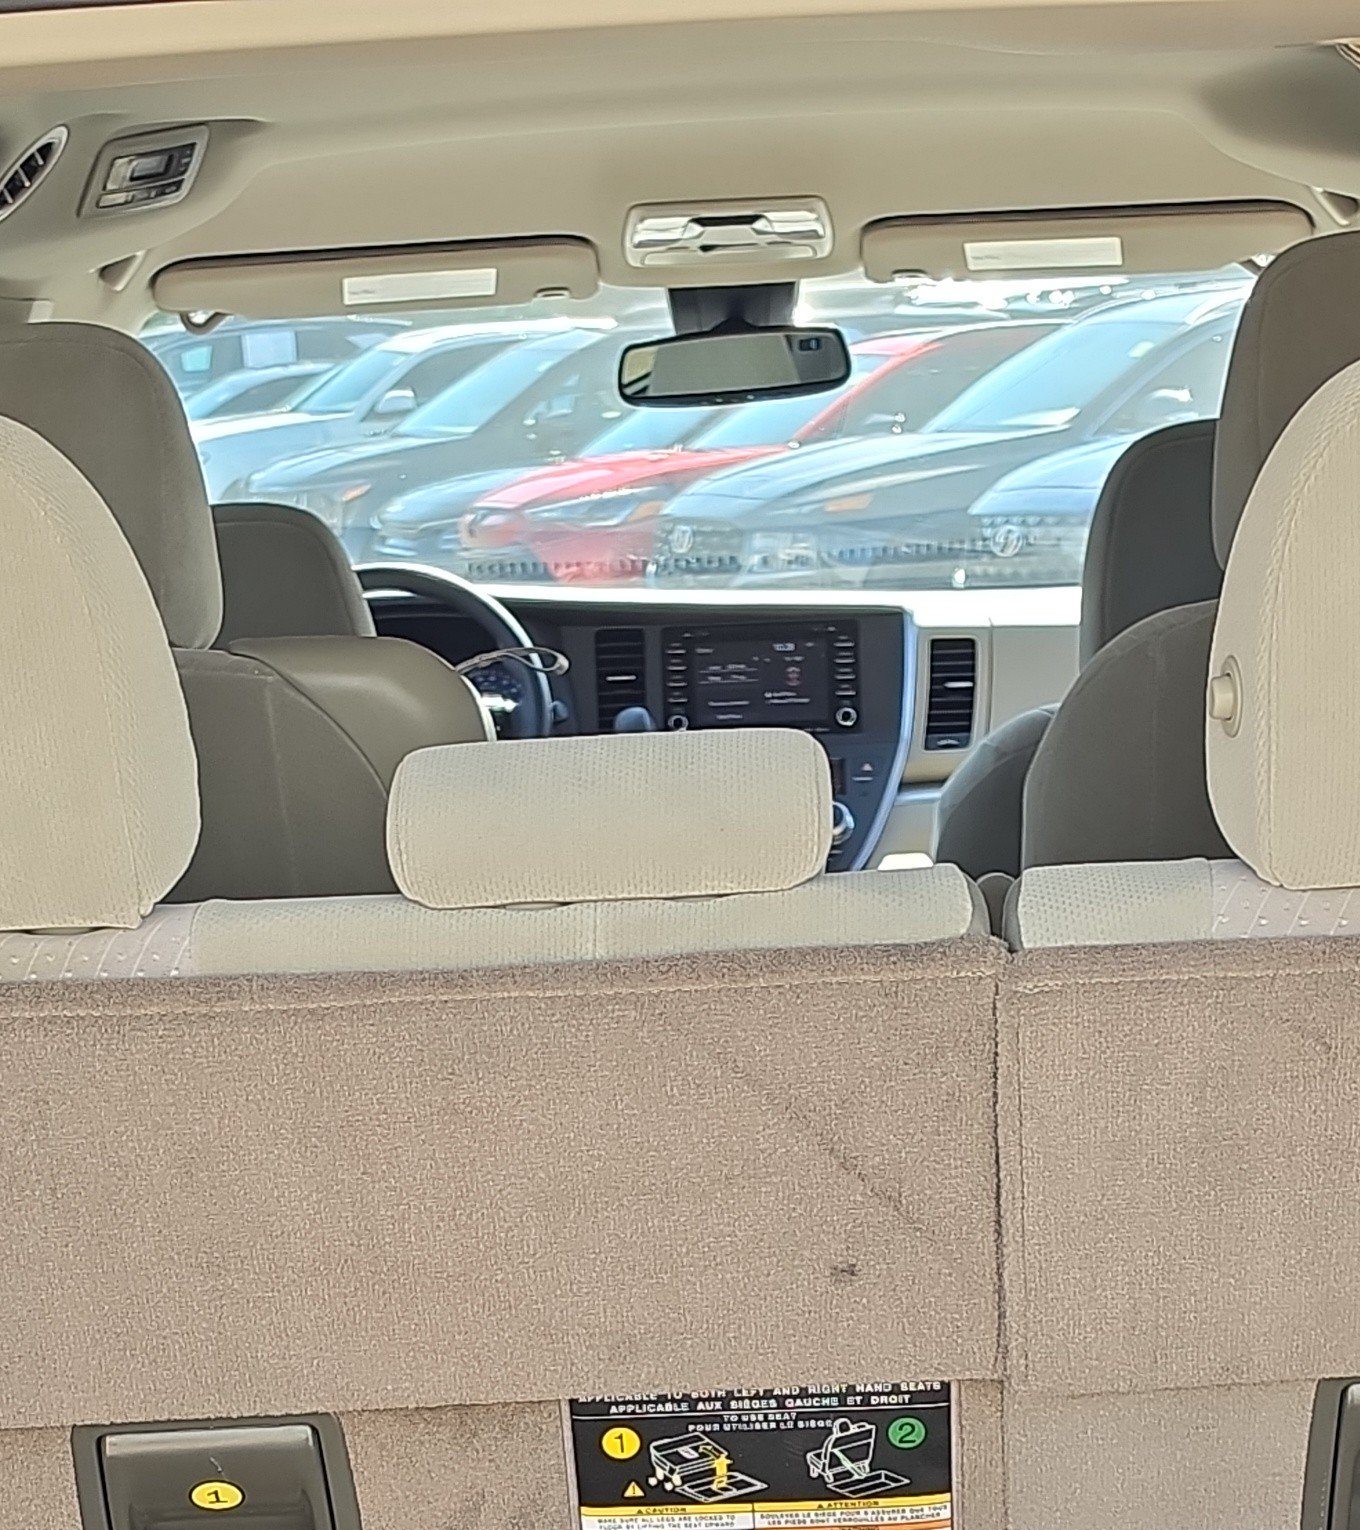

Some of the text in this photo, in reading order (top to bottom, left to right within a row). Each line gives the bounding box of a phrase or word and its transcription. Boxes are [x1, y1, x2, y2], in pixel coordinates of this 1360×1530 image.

[772, 1386, 800, 1396] AND
[808, 1383, 848, 1395] RIGHT
[855, 1382, 893, 1393] HAND
[900, 1381, 941, 1392] SEATS
[610, 1402, 689, 1414] APPLICABLE
[696, 1401, 723, 1411] AUX
[846, 1395, 864, 1405] ET
[870, 1394, 911, 1405] DROIT
[898, 1423, 916, 1444] 2
[827, 1500, 879, 1509] ATTENTION
